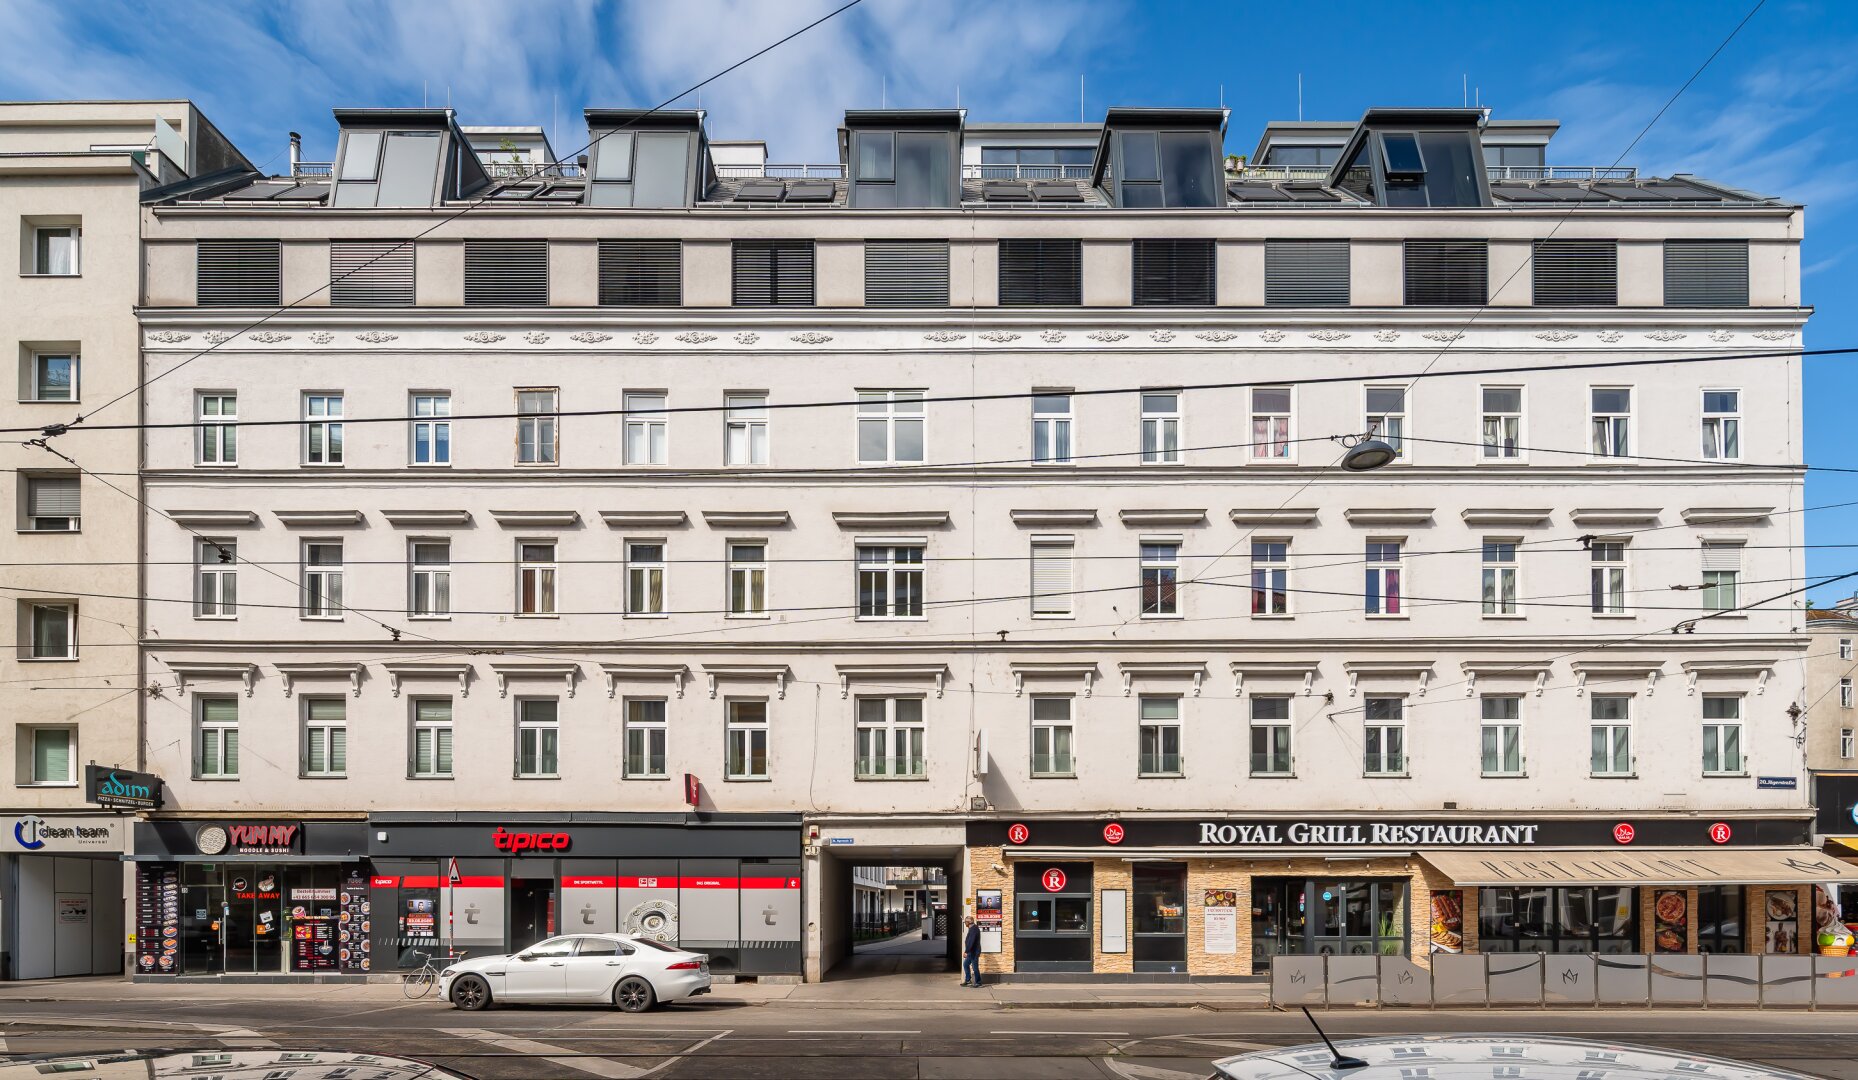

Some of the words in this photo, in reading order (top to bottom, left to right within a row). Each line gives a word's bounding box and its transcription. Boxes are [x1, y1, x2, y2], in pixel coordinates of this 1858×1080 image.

[101, 771, 149, 798] adim
[76, 826, 110, 838] team
[229, 825, 297, 846] YUMMY
[491, 826, 570, 853] tipico
[1014, 831, 1024, 840] R
[1199, 823, 1283, 844] ROYAL
[1287, 823, 1367, 844] GRILL
[1370, 823, 1538, 844] RESTAURANT
[1716, 830, 1726, 840] R
[1048, 876, 1060, 888] R
